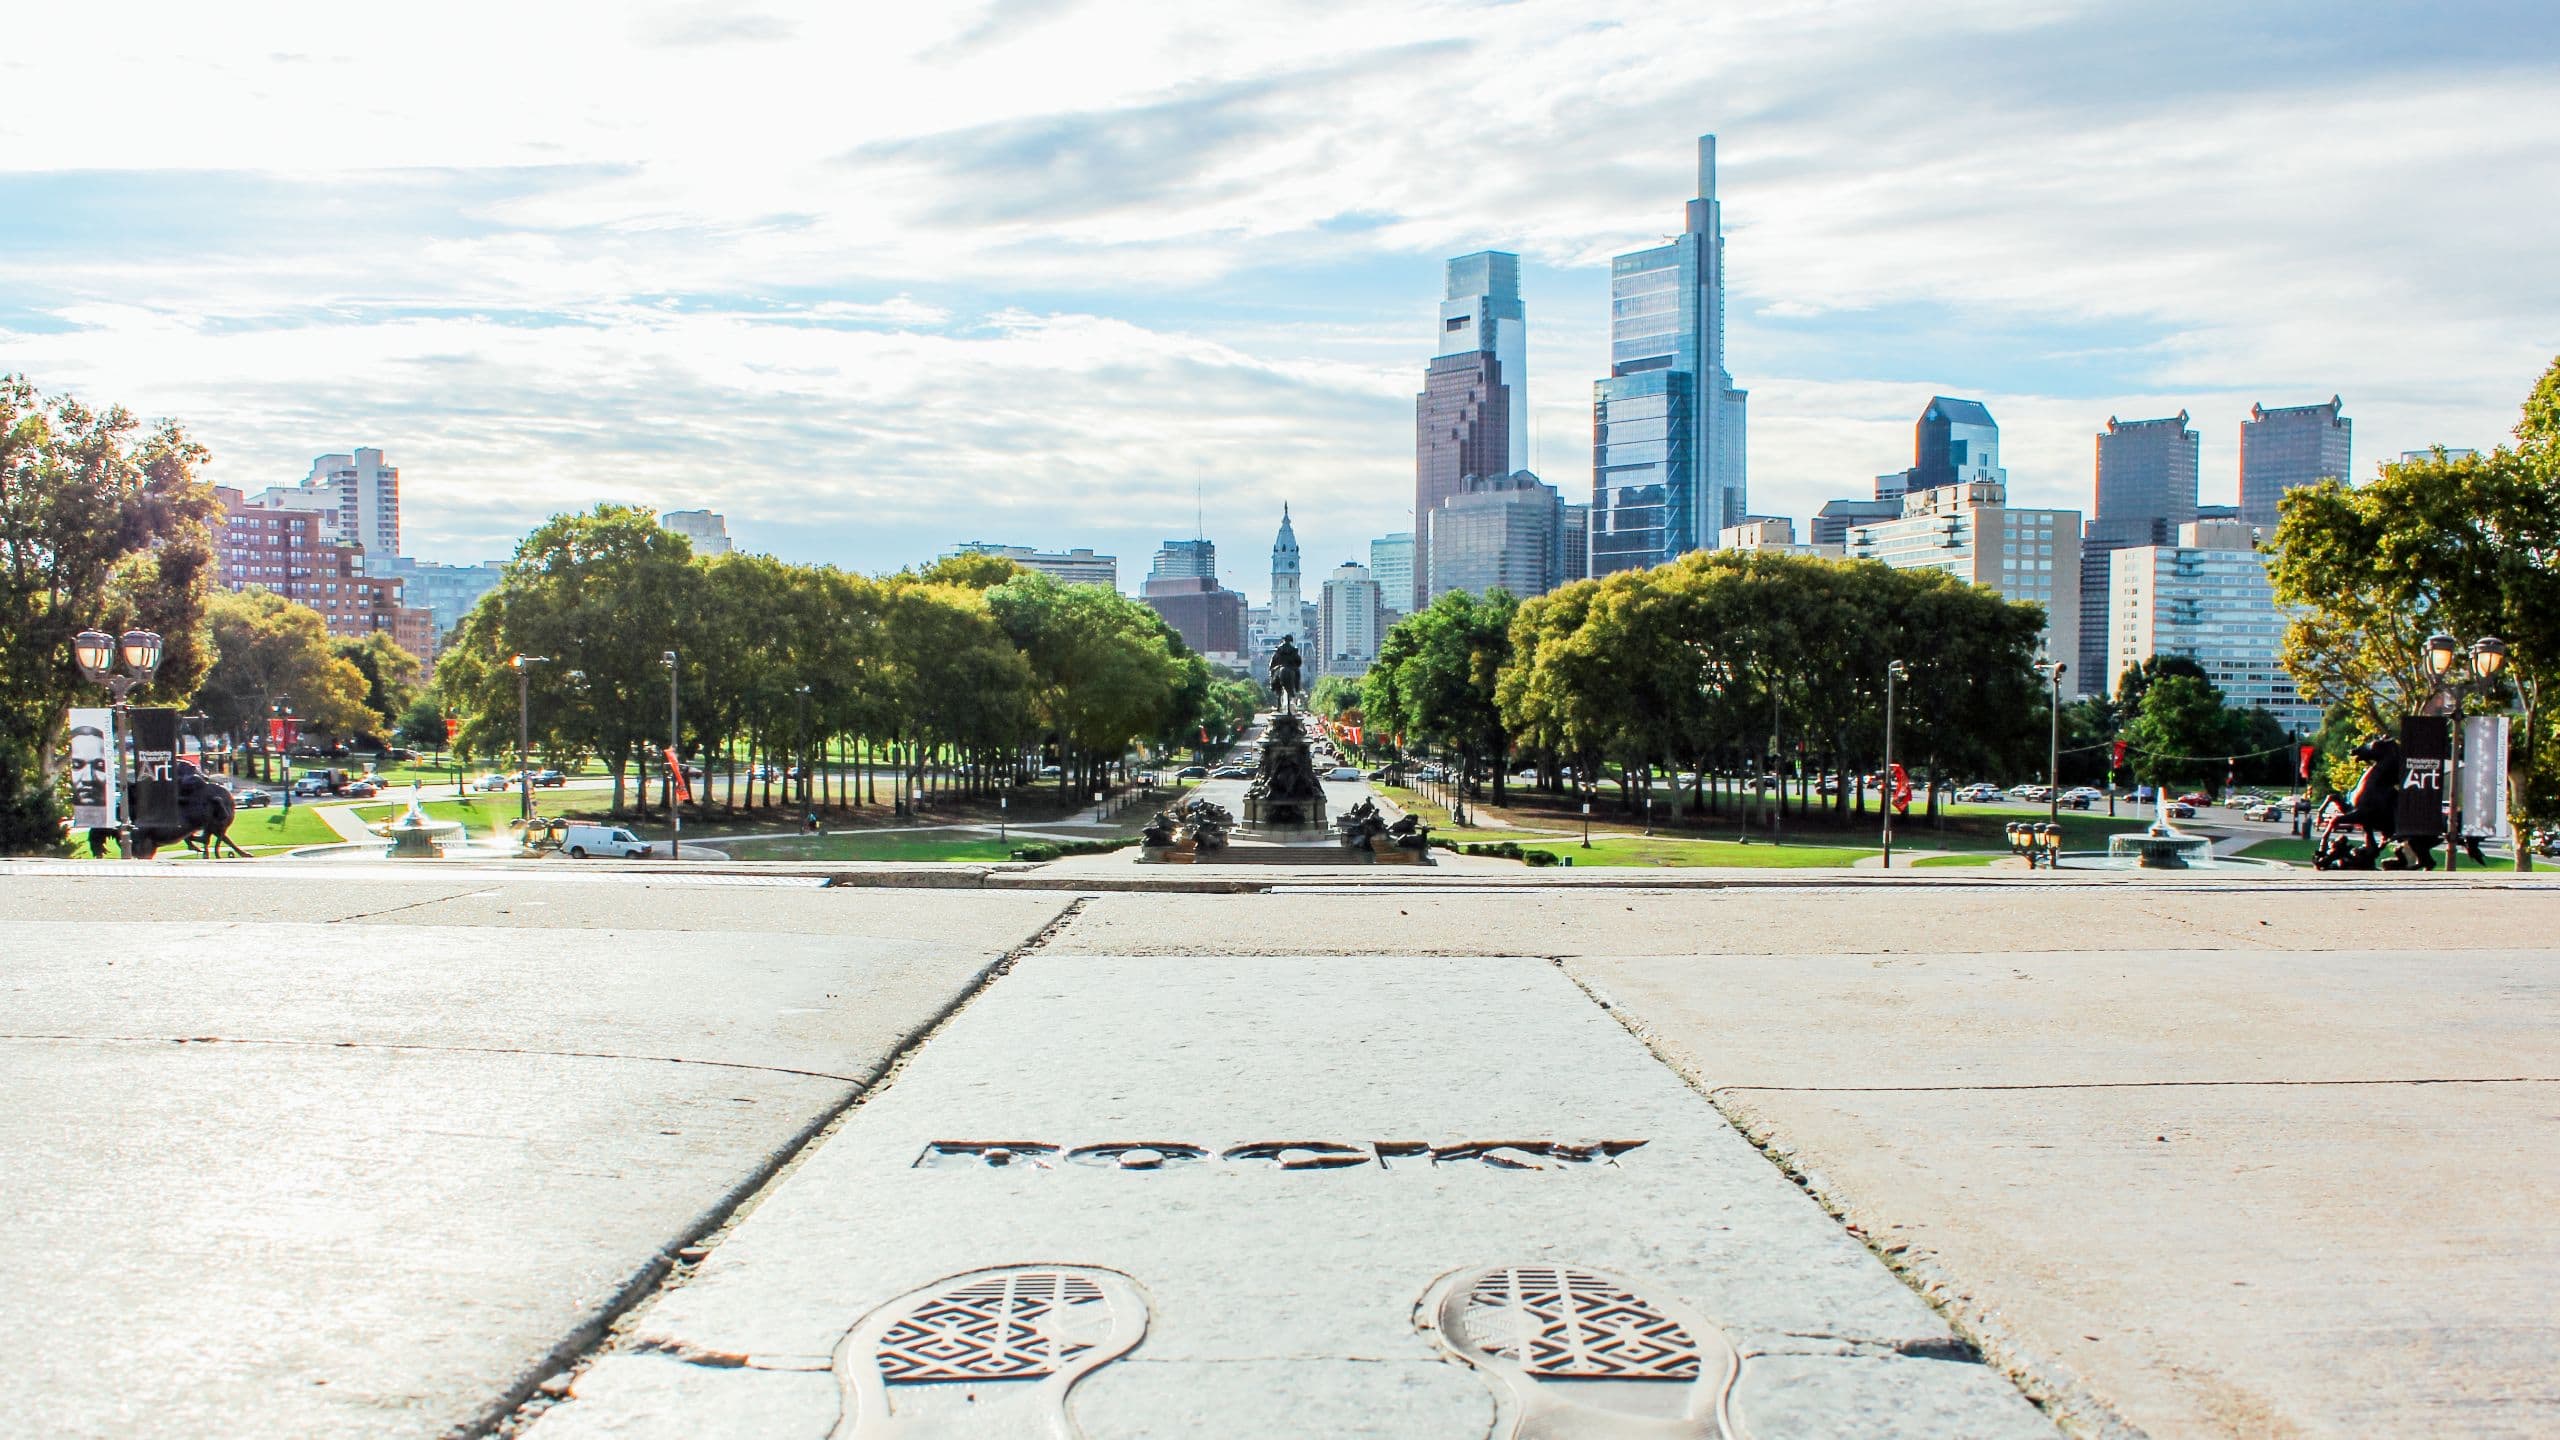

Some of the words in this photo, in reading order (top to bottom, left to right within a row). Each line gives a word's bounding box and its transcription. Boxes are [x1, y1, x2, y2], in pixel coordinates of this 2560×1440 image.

[137, 760, 172, 781] Art
[2403, 769, 2440, 789] Art
[911, 1140, 1649, 1170] ROCKY
